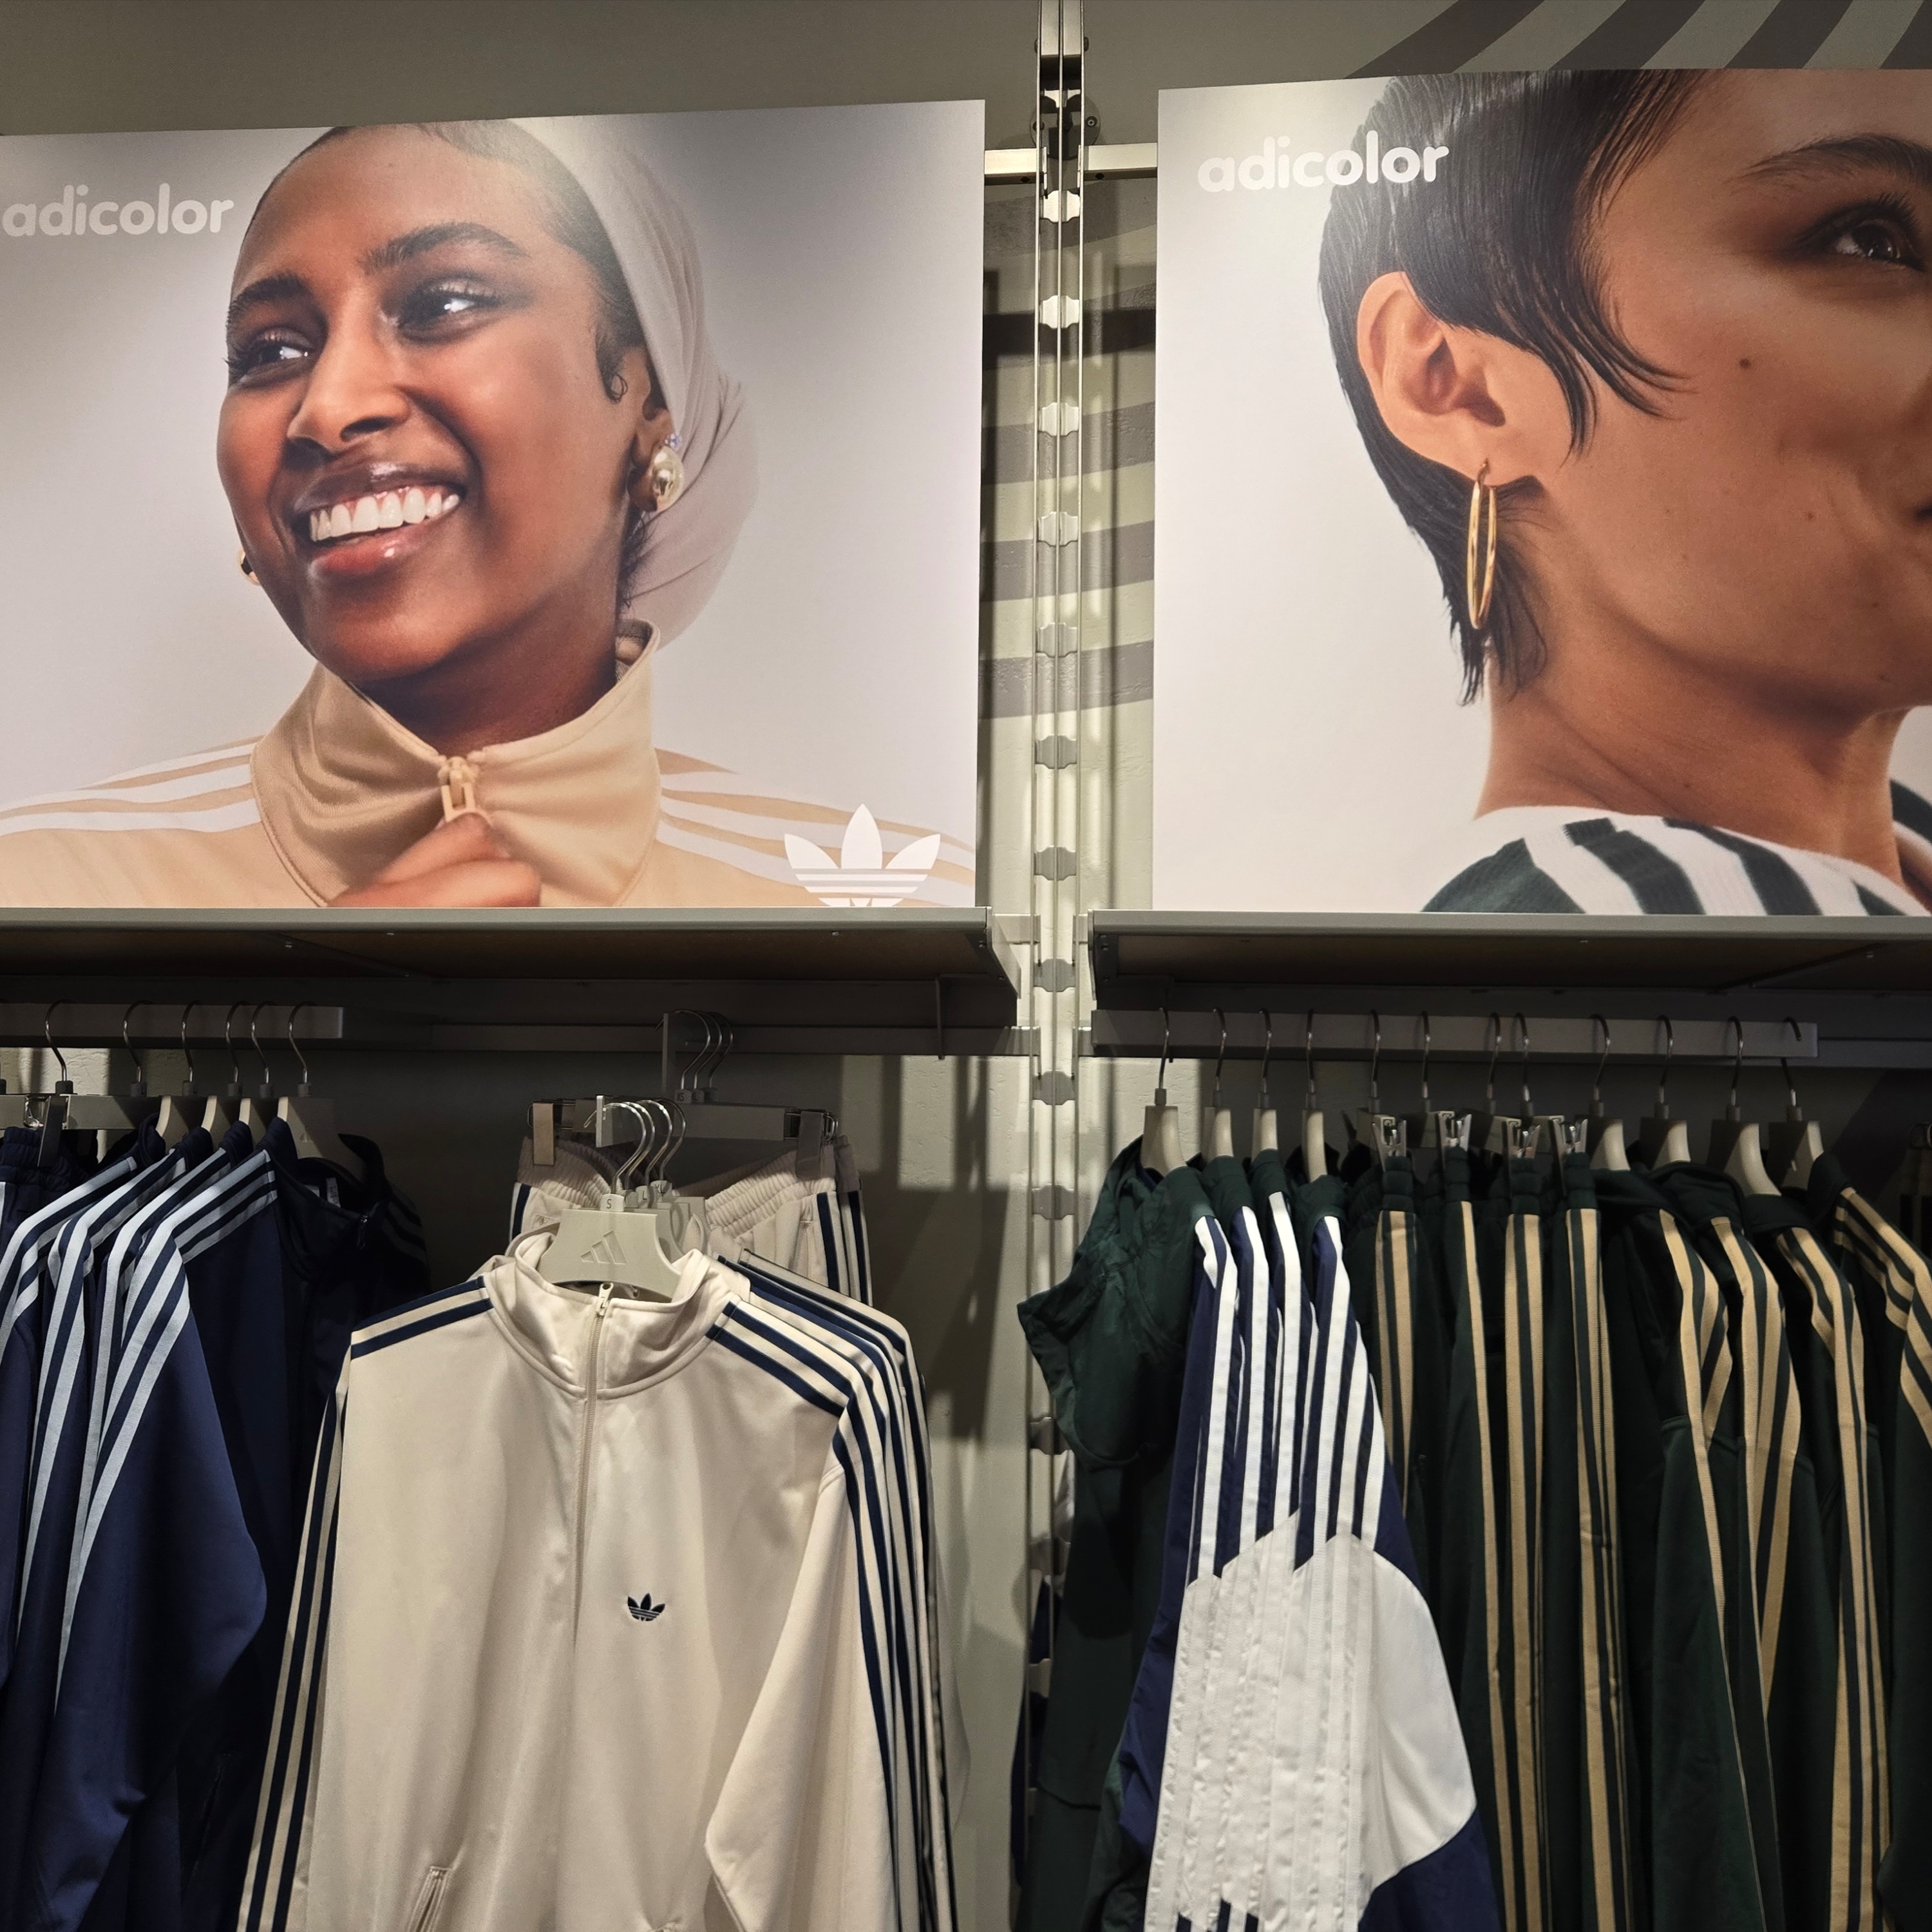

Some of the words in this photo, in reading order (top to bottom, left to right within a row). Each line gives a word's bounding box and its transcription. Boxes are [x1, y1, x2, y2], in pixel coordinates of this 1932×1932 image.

[1198, 130, 1450, 192] adicolor
[2, 183, 234, 236] adicolor
[654, 1183, 667, 1194] XL
[642, 1190, 648, 1200] L
[607, 1198, 612, 1209] S
